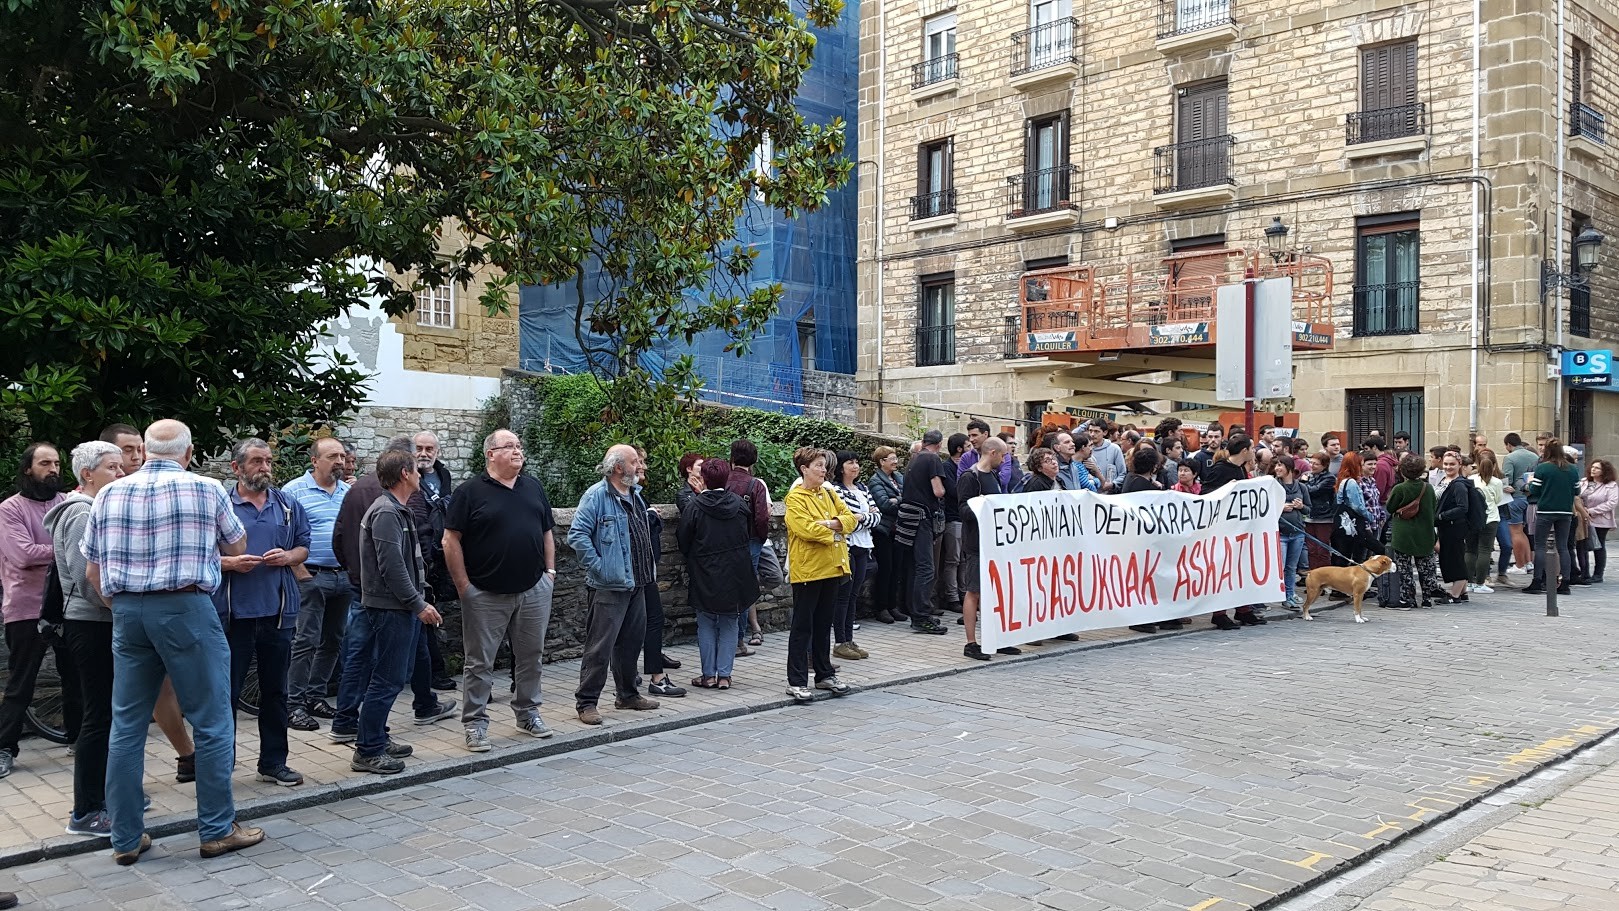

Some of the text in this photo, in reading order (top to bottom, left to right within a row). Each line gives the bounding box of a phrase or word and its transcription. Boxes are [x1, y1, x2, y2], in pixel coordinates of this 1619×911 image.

[1153, 334, 1203, 344] 902.20.444
[1035, 342, 1072, 351] ALQUILER
[1072, 408, 1109, 420] ALQUILER
[1095, 498, 1221, 536] DEMOKRAZIA
[1225, 486, 1270, 521] ZERO
[988, 530, 1286, 633] ALTSASUKOAK ASKATU!
